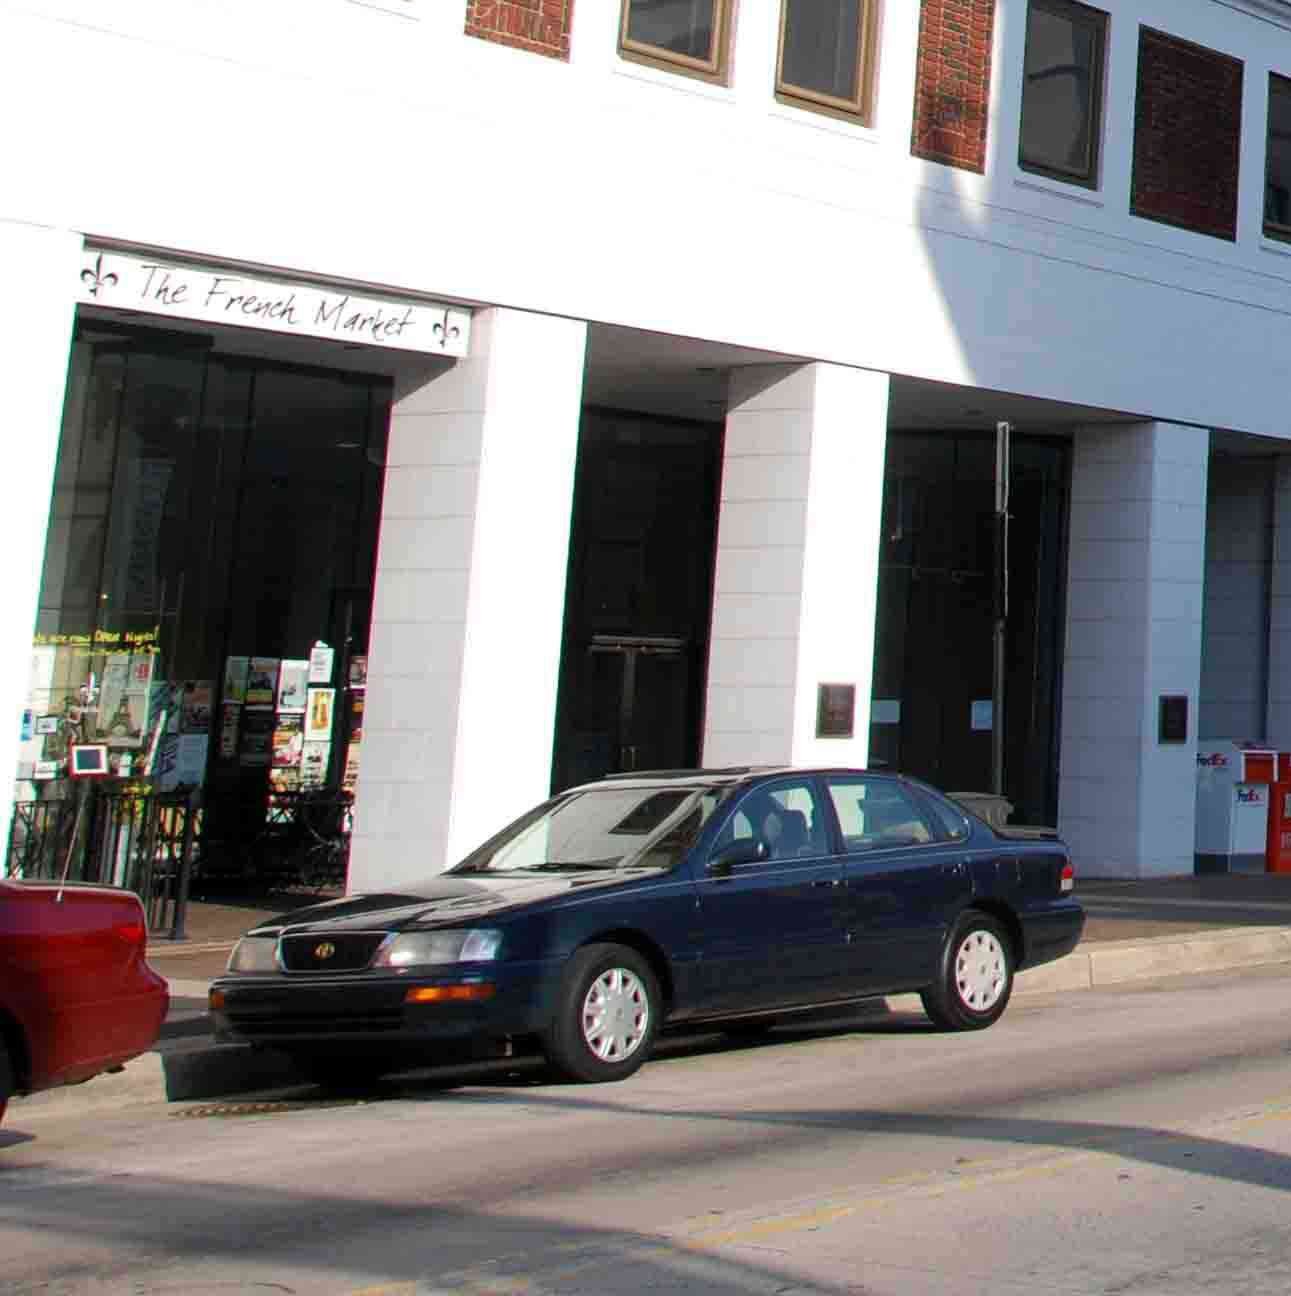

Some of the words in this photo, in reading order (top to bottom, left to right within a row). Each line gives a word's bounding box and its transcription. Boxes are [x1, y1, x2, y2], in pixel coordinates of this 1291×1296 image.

[141, 264, 188, 305] The
[206, 278, 300, 324] French
[314, 296, 418, 342] Market
